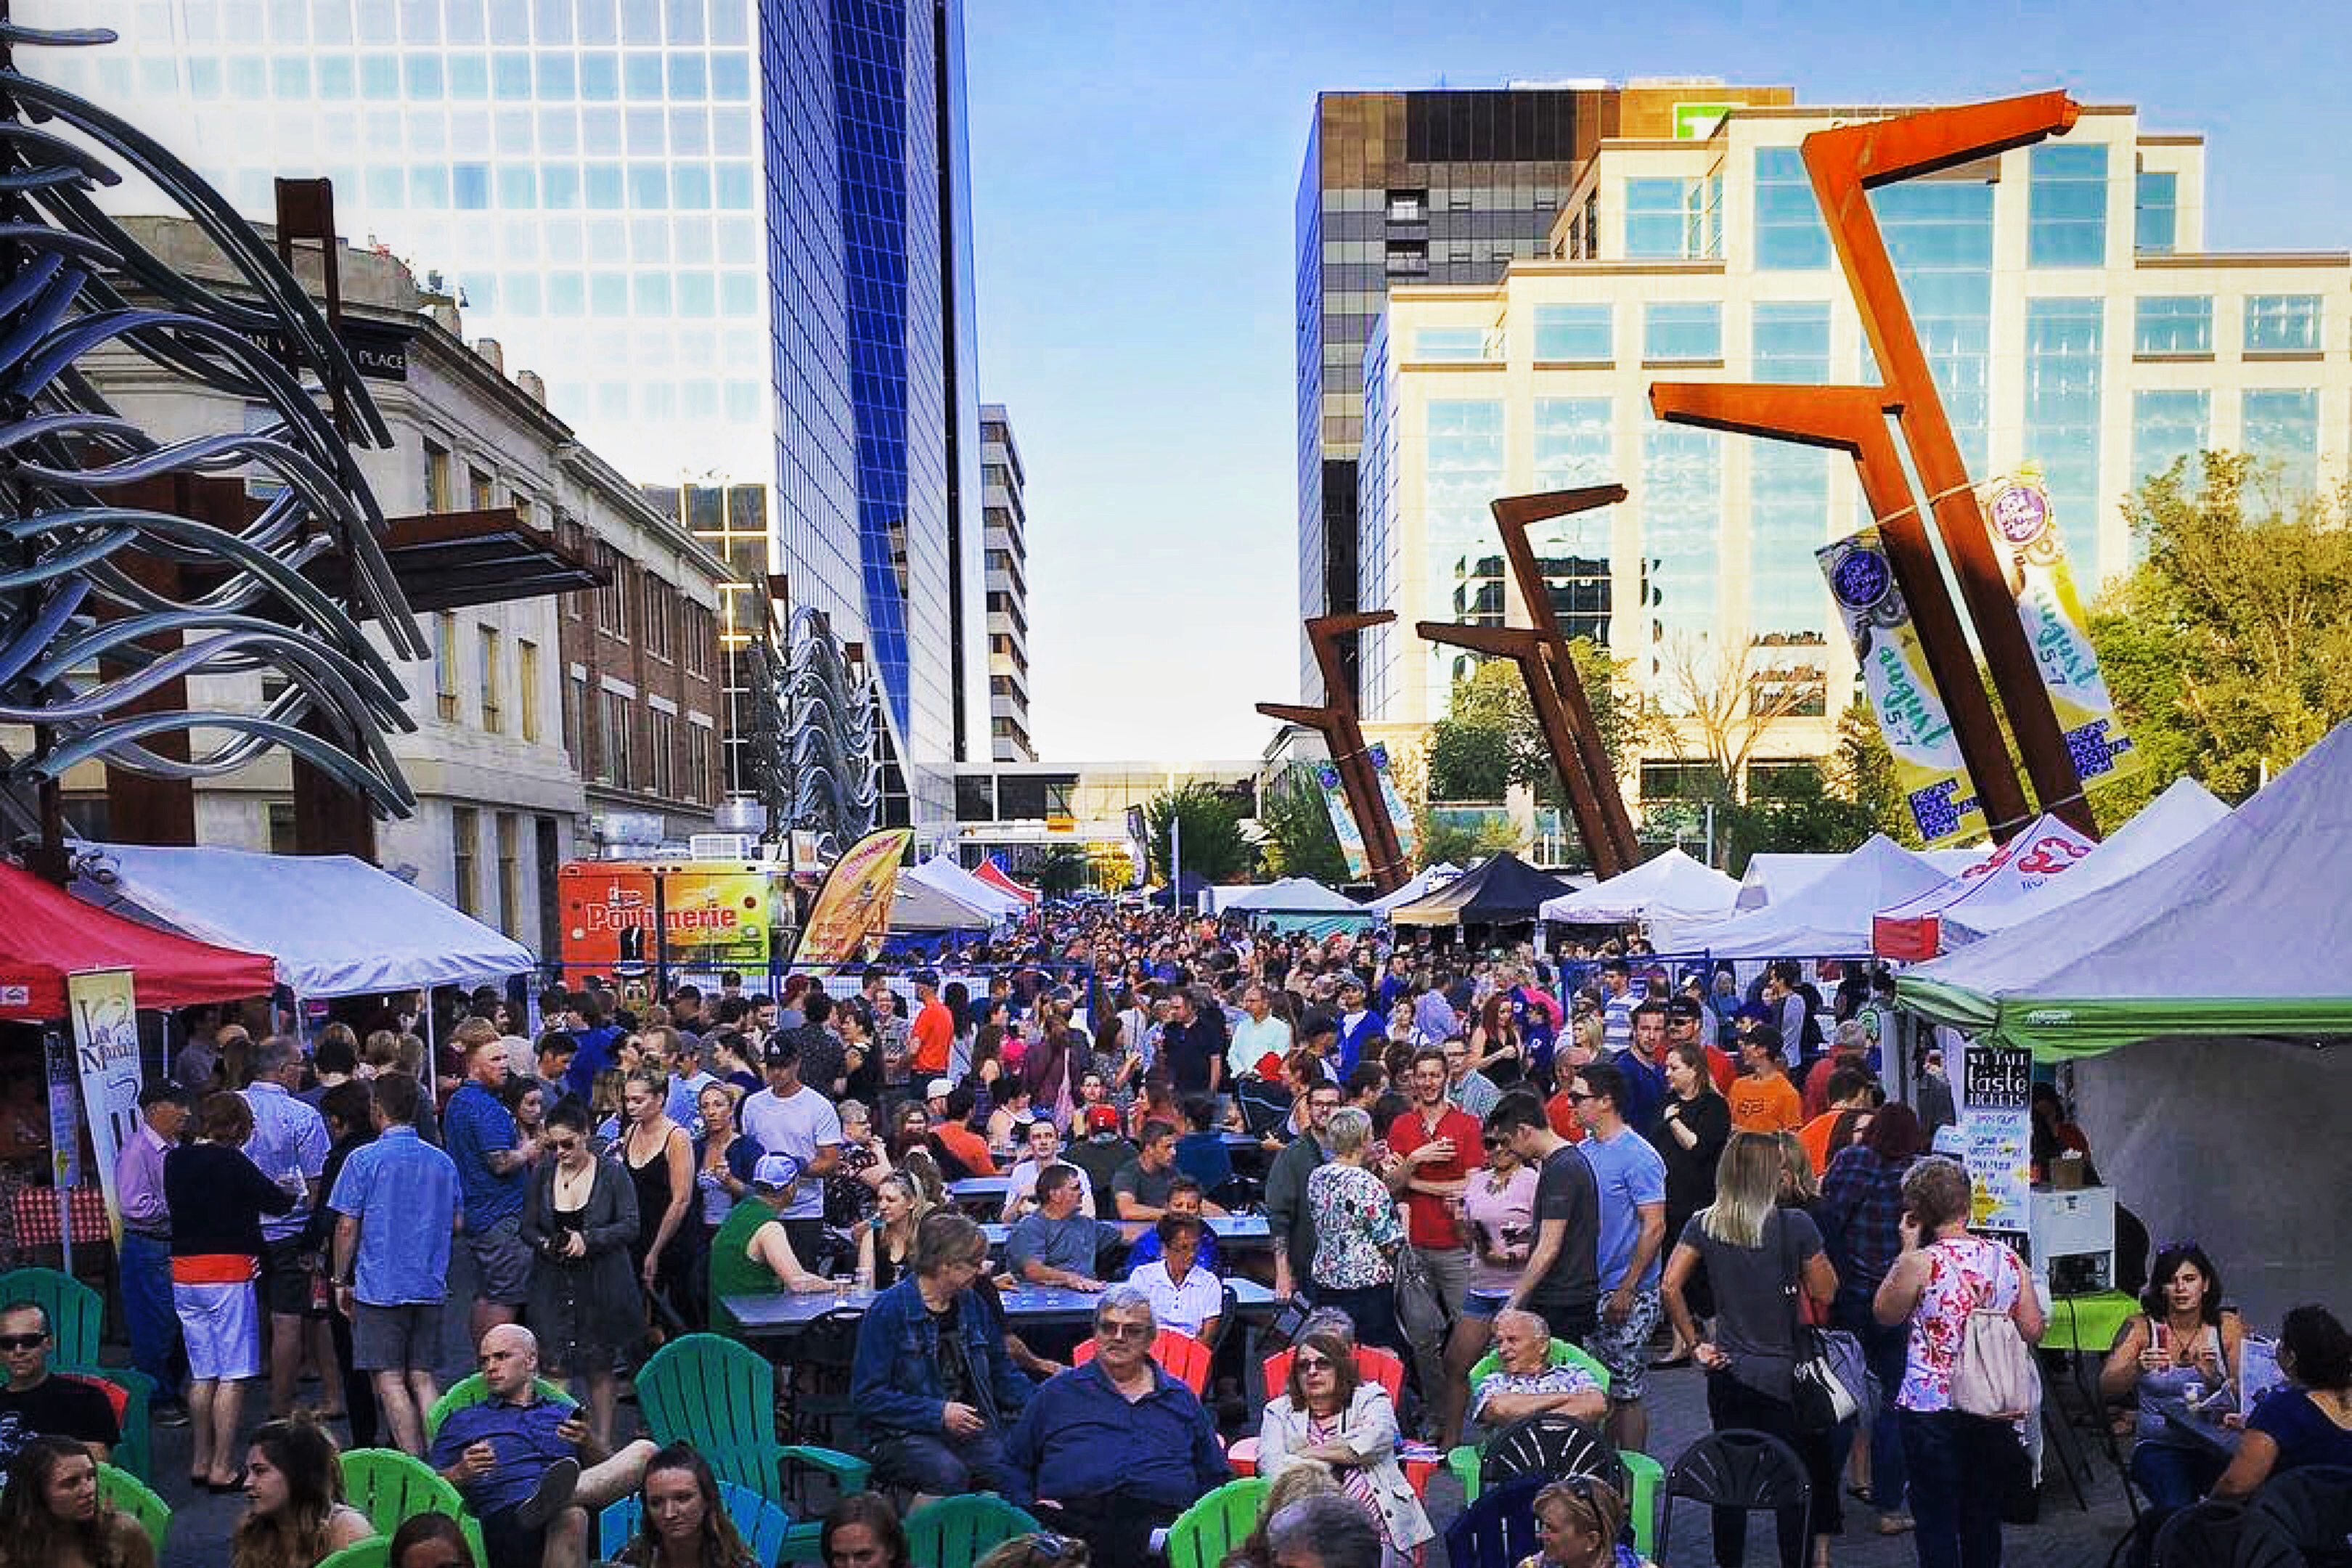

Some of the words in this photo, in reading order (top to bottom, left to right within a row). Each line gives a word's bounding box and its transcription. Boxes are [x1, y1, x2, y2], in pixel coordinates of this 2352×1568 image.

[359, 349, 404, 369] PLACE
[587, 903, 738, 931] Poutinerie
[1968, 1064, 2028, 1094] taste
